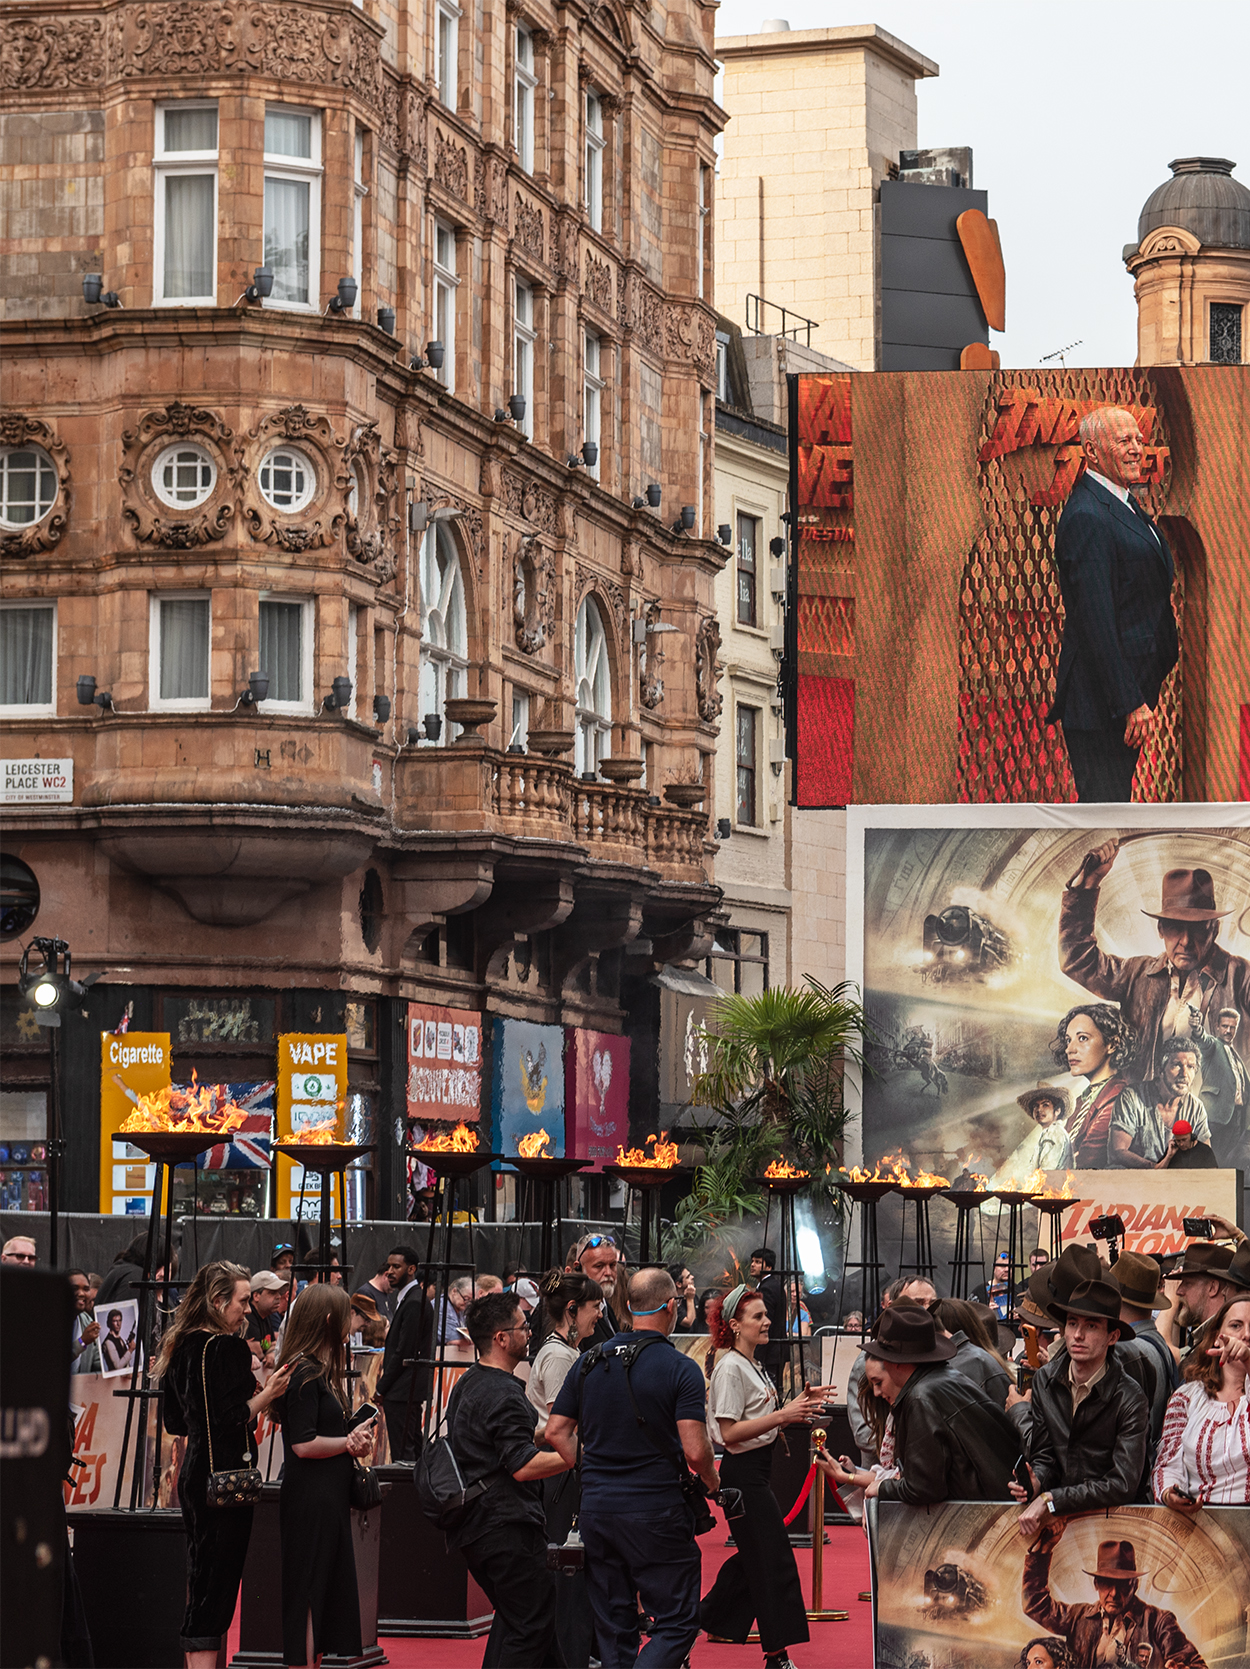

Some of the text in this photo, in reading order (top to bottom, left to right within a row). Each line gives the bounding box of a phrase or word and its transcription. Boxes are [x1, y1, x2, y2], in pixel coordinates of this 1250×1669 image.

[5, 763, 61, 776] LEICESTER
[5, 776, 67, 789] PLACE WC2
[110, 1041, 163, 1069] Cigarette
[289, 1042, 338, 1066] VAPE
